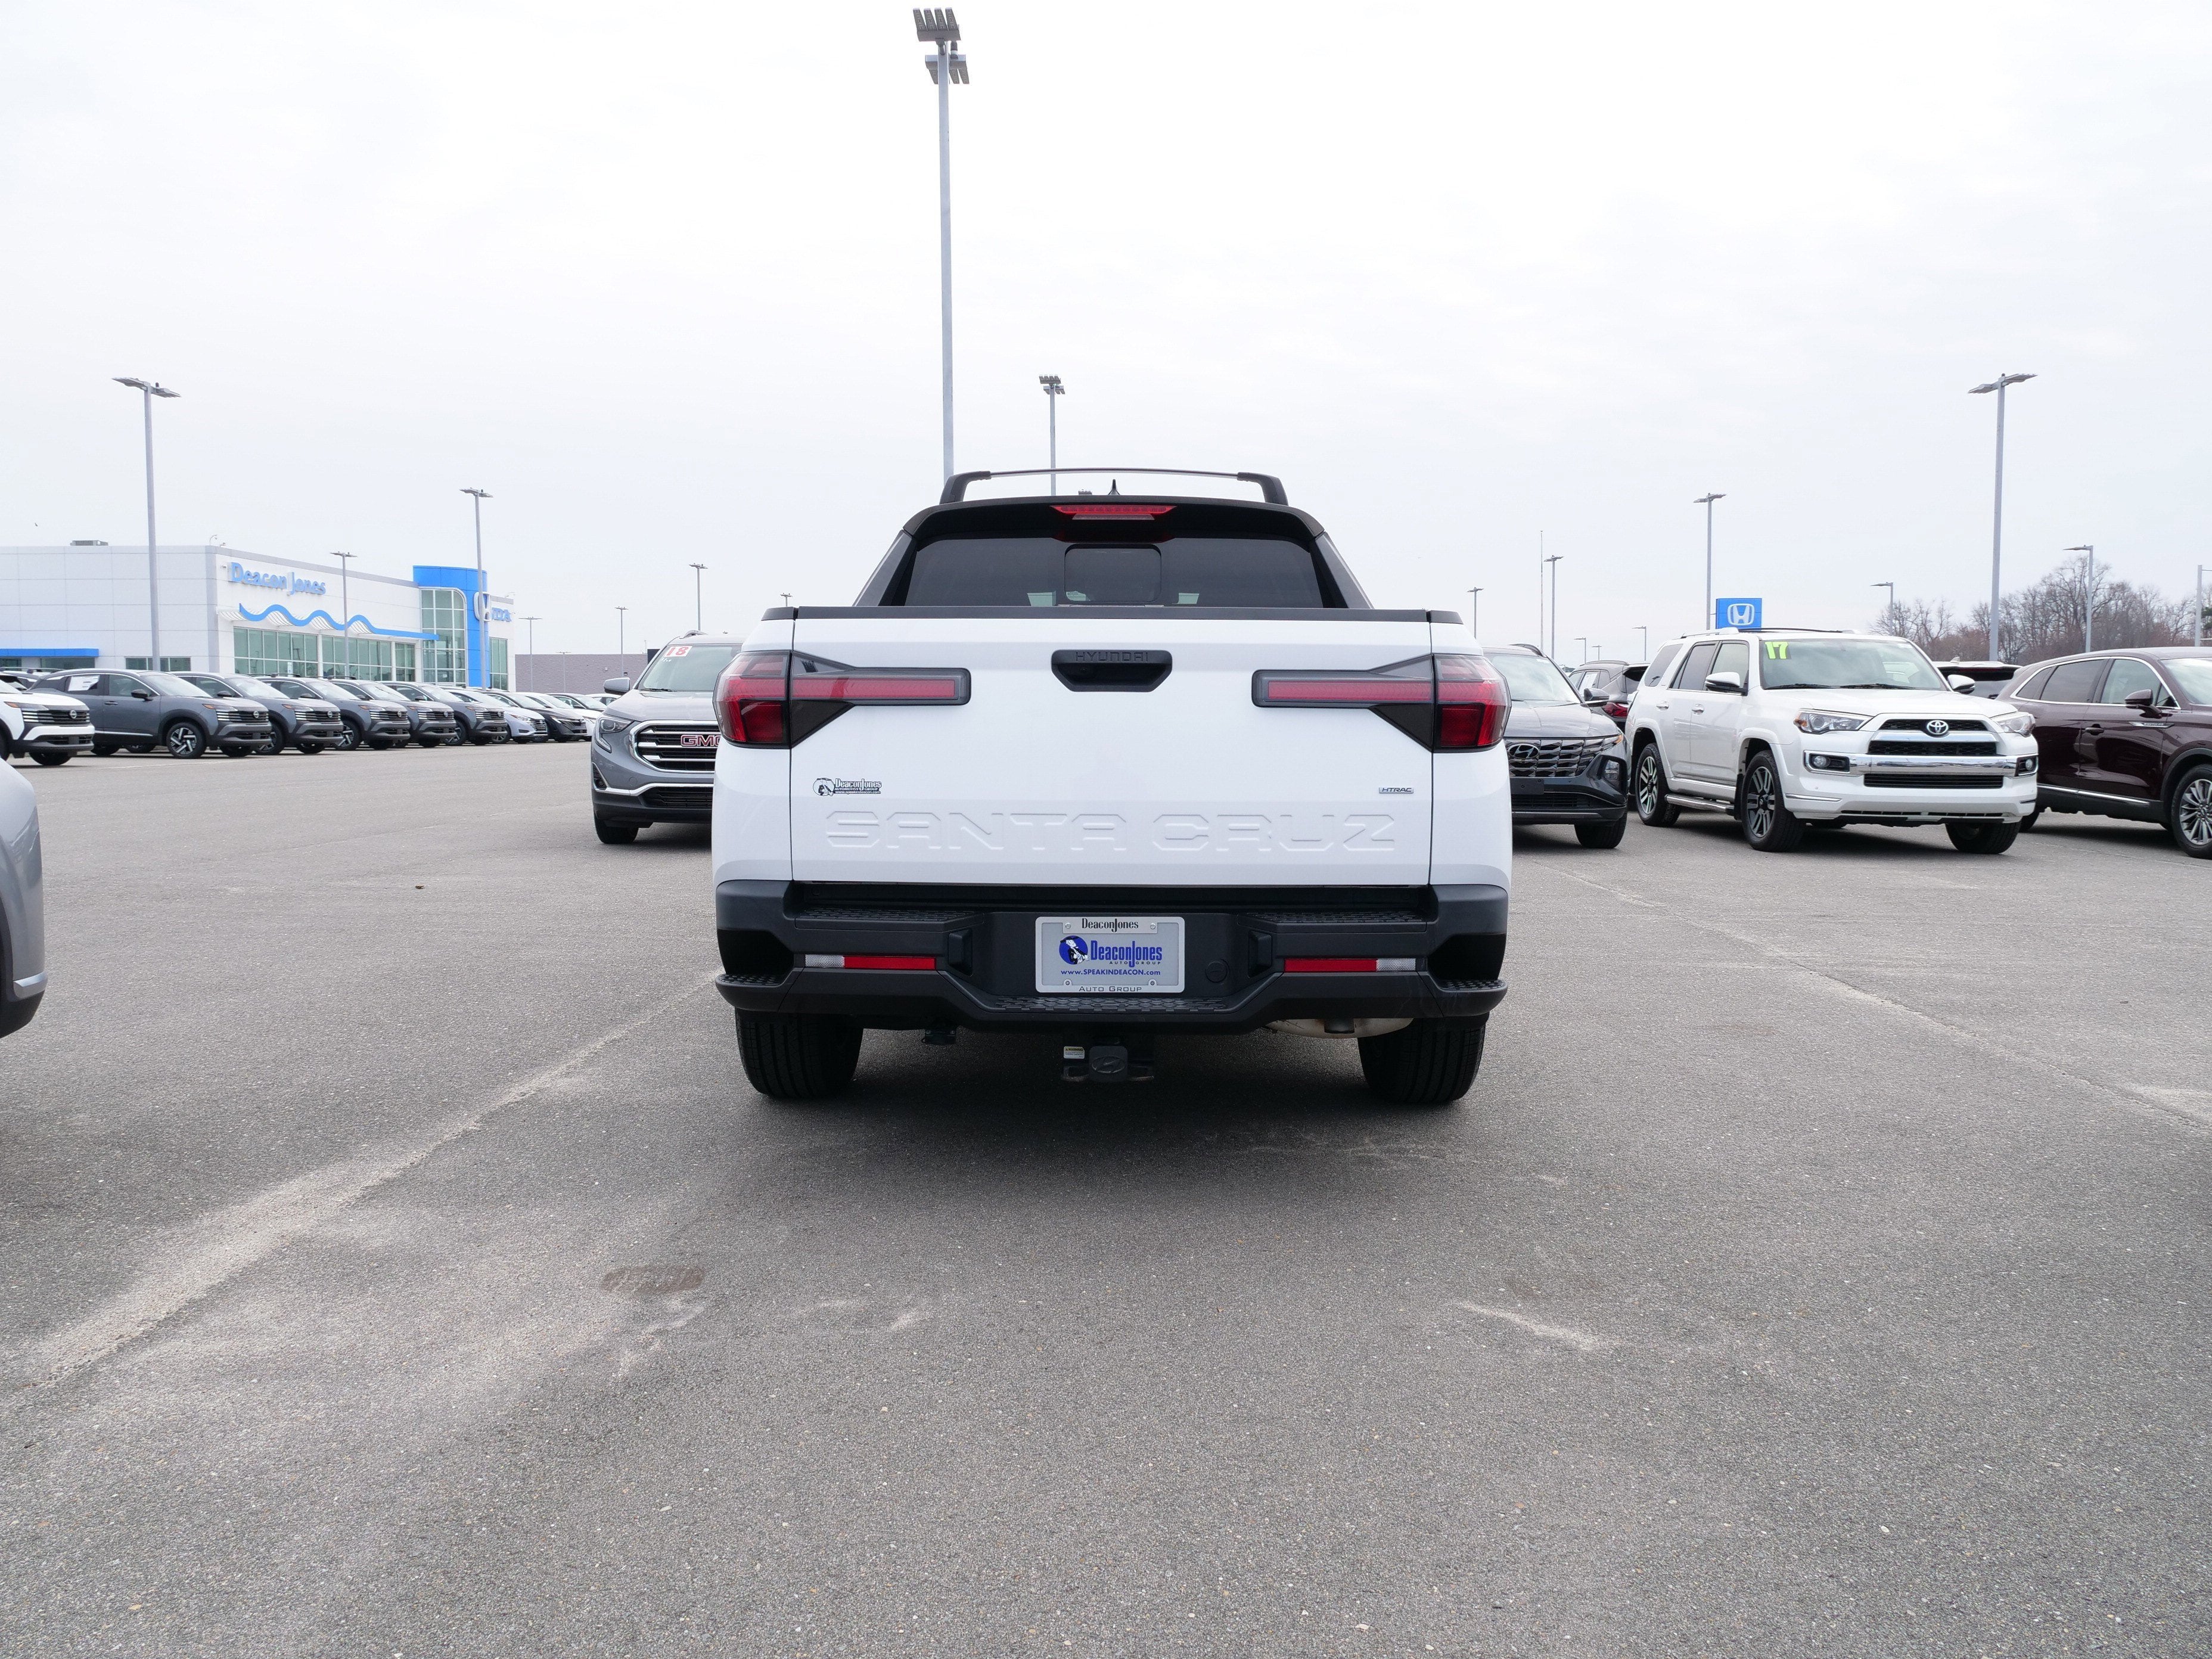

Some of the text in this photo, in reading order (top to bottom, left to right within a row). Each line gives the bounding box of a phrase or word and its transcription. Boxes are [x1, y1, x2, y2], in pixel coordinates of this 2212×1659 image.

[228, 562, 326, 595] Deacon Jones
[666, 647, 689, 656] 18
[1075, 652, 1149, 662] HYUNDAI
[1764, 641, 1788, 659] 17
[827, 810, 1396, 852] SANTA CRUZ
